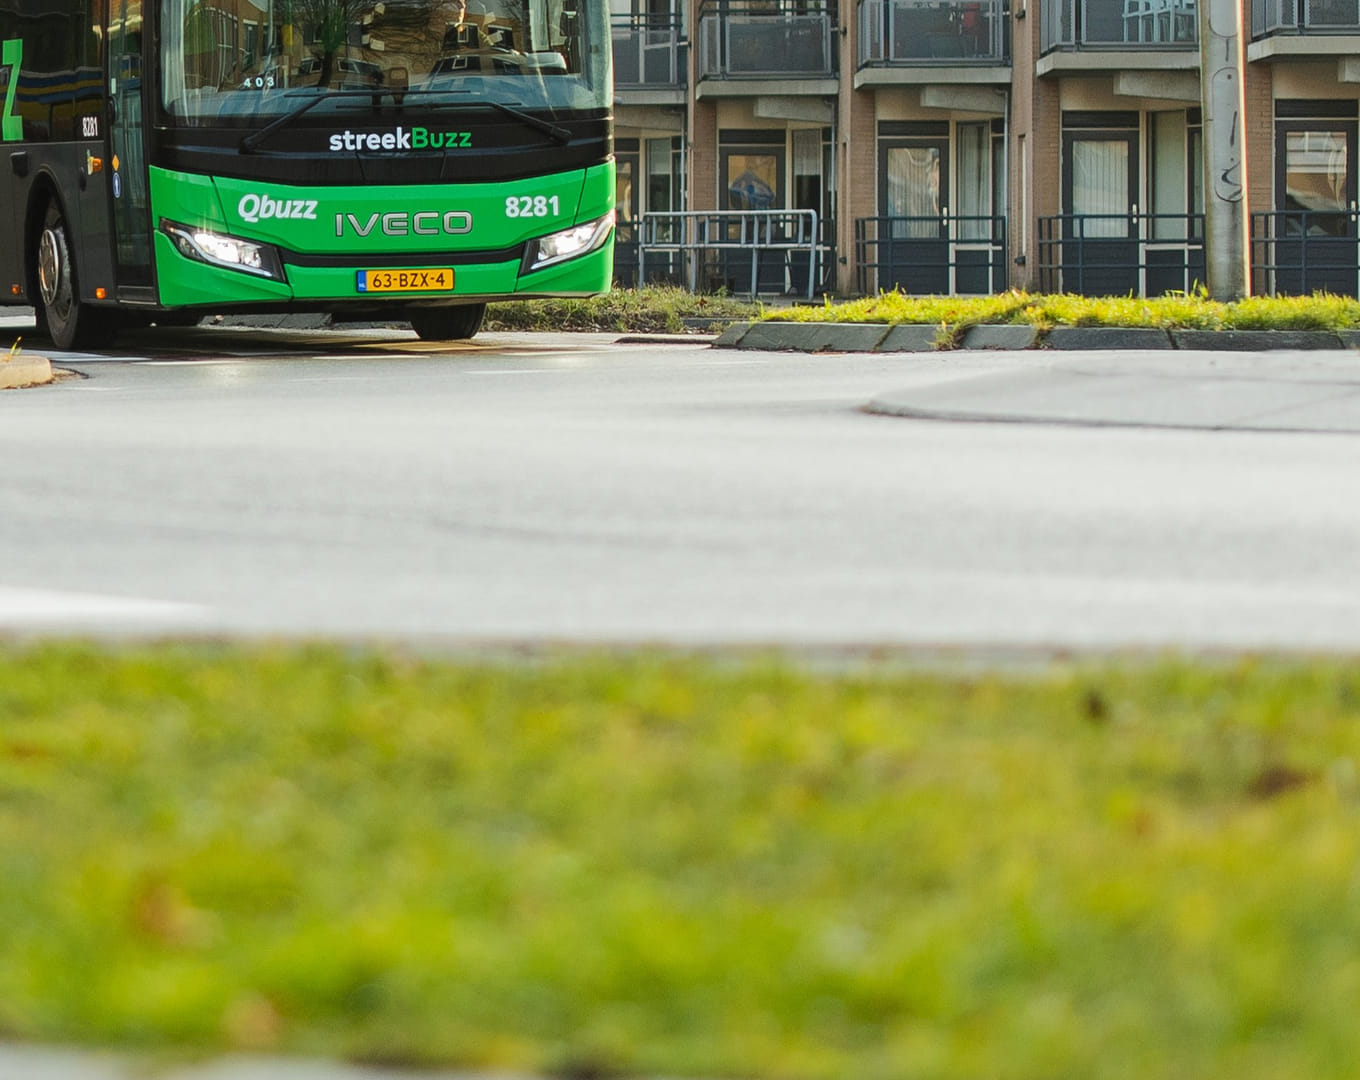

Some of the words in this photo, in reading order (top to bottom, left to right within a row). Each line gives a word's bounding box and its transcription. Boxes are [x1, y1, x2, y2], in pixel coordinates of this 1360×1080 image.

[243, 76, 275, 88] 403
[82, 116, 98, 137] 8281
[329, 126, 472, 151] streekBuzz
[237, 193, 318, 223] Qbuzz
[505, 195, 560, 218] 8281
[335, 210, 473, 238] IVECO
[372, 272, 446, 289] 63-BZX-4
